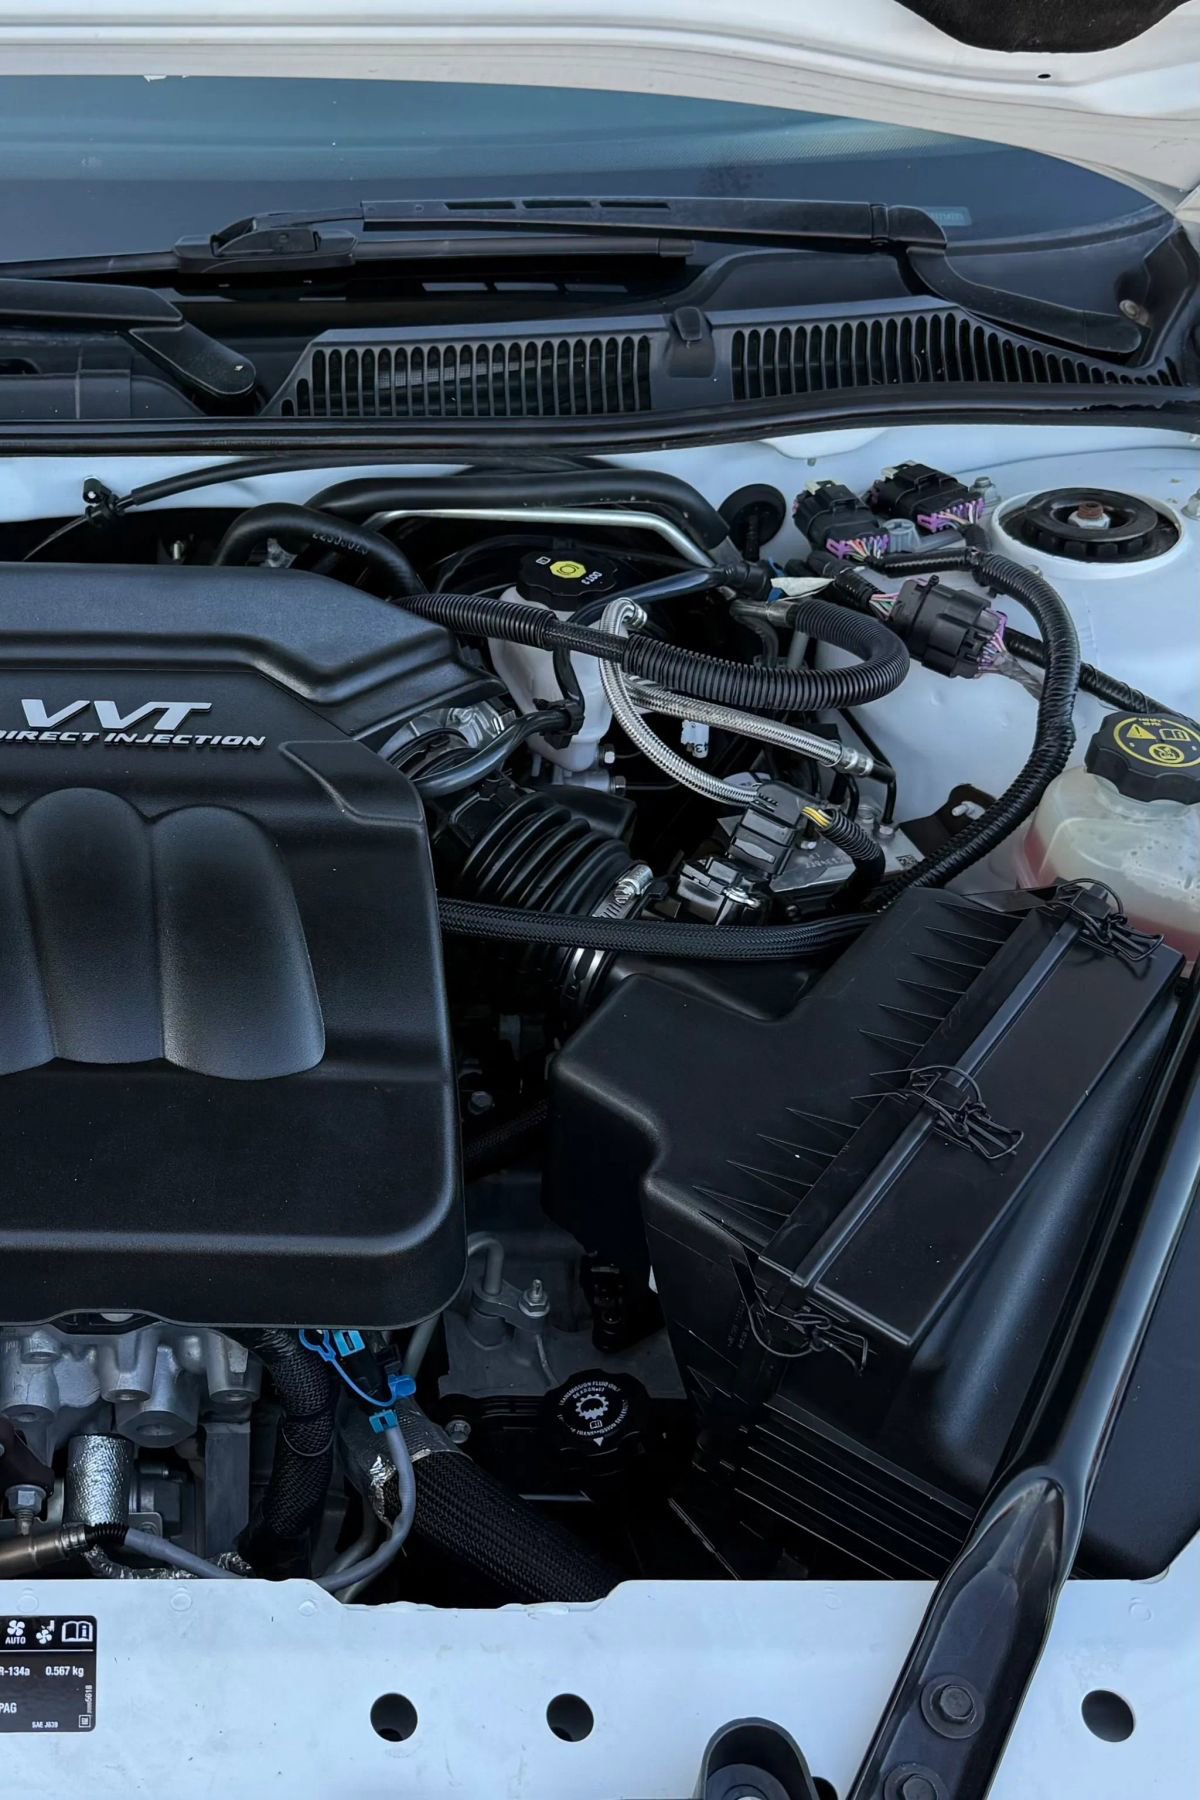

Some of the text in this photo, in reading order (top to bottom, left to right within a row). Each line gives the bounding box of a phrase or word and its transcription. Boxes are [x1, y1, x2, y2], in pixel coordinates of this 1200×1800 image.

[21, 698, 212, 732] VVT
[104, 731, 266, 748] INJECTION
[5, 1636, 26, 1644] AUTO
[46, 1666, 70, 1676] 0.567
[72, 1666, 84, 1678] kg
